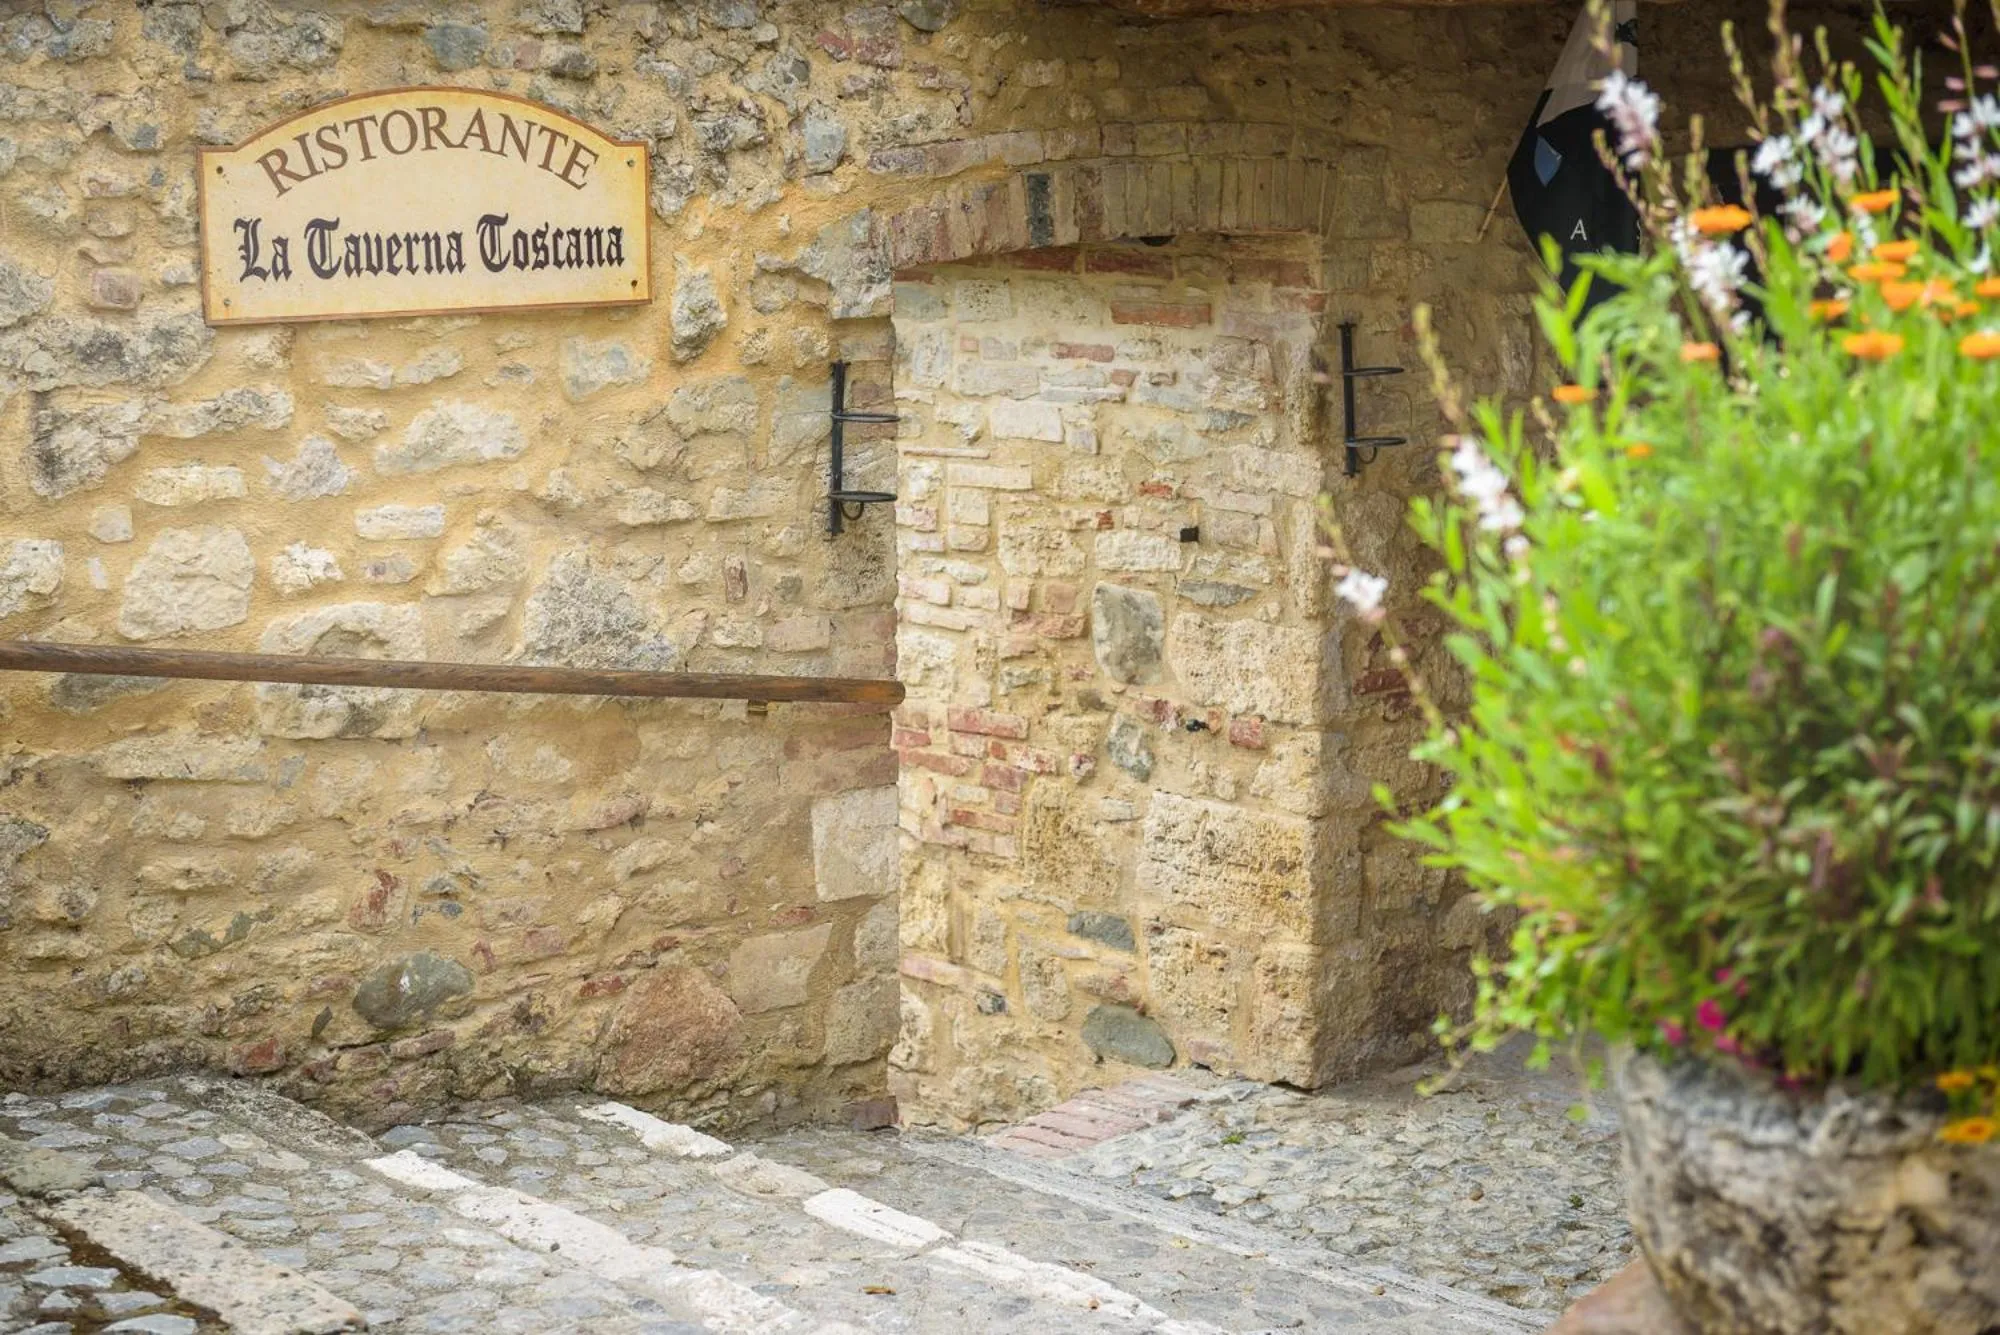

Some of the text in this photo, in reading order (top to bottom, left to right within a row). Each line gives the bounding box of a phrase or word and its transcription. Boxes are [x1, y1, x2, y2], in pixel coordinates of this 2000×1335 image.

[256, 106, 599, 198] RISTORANTE
[233, 212, 625, 283] La Taverna Toscana
